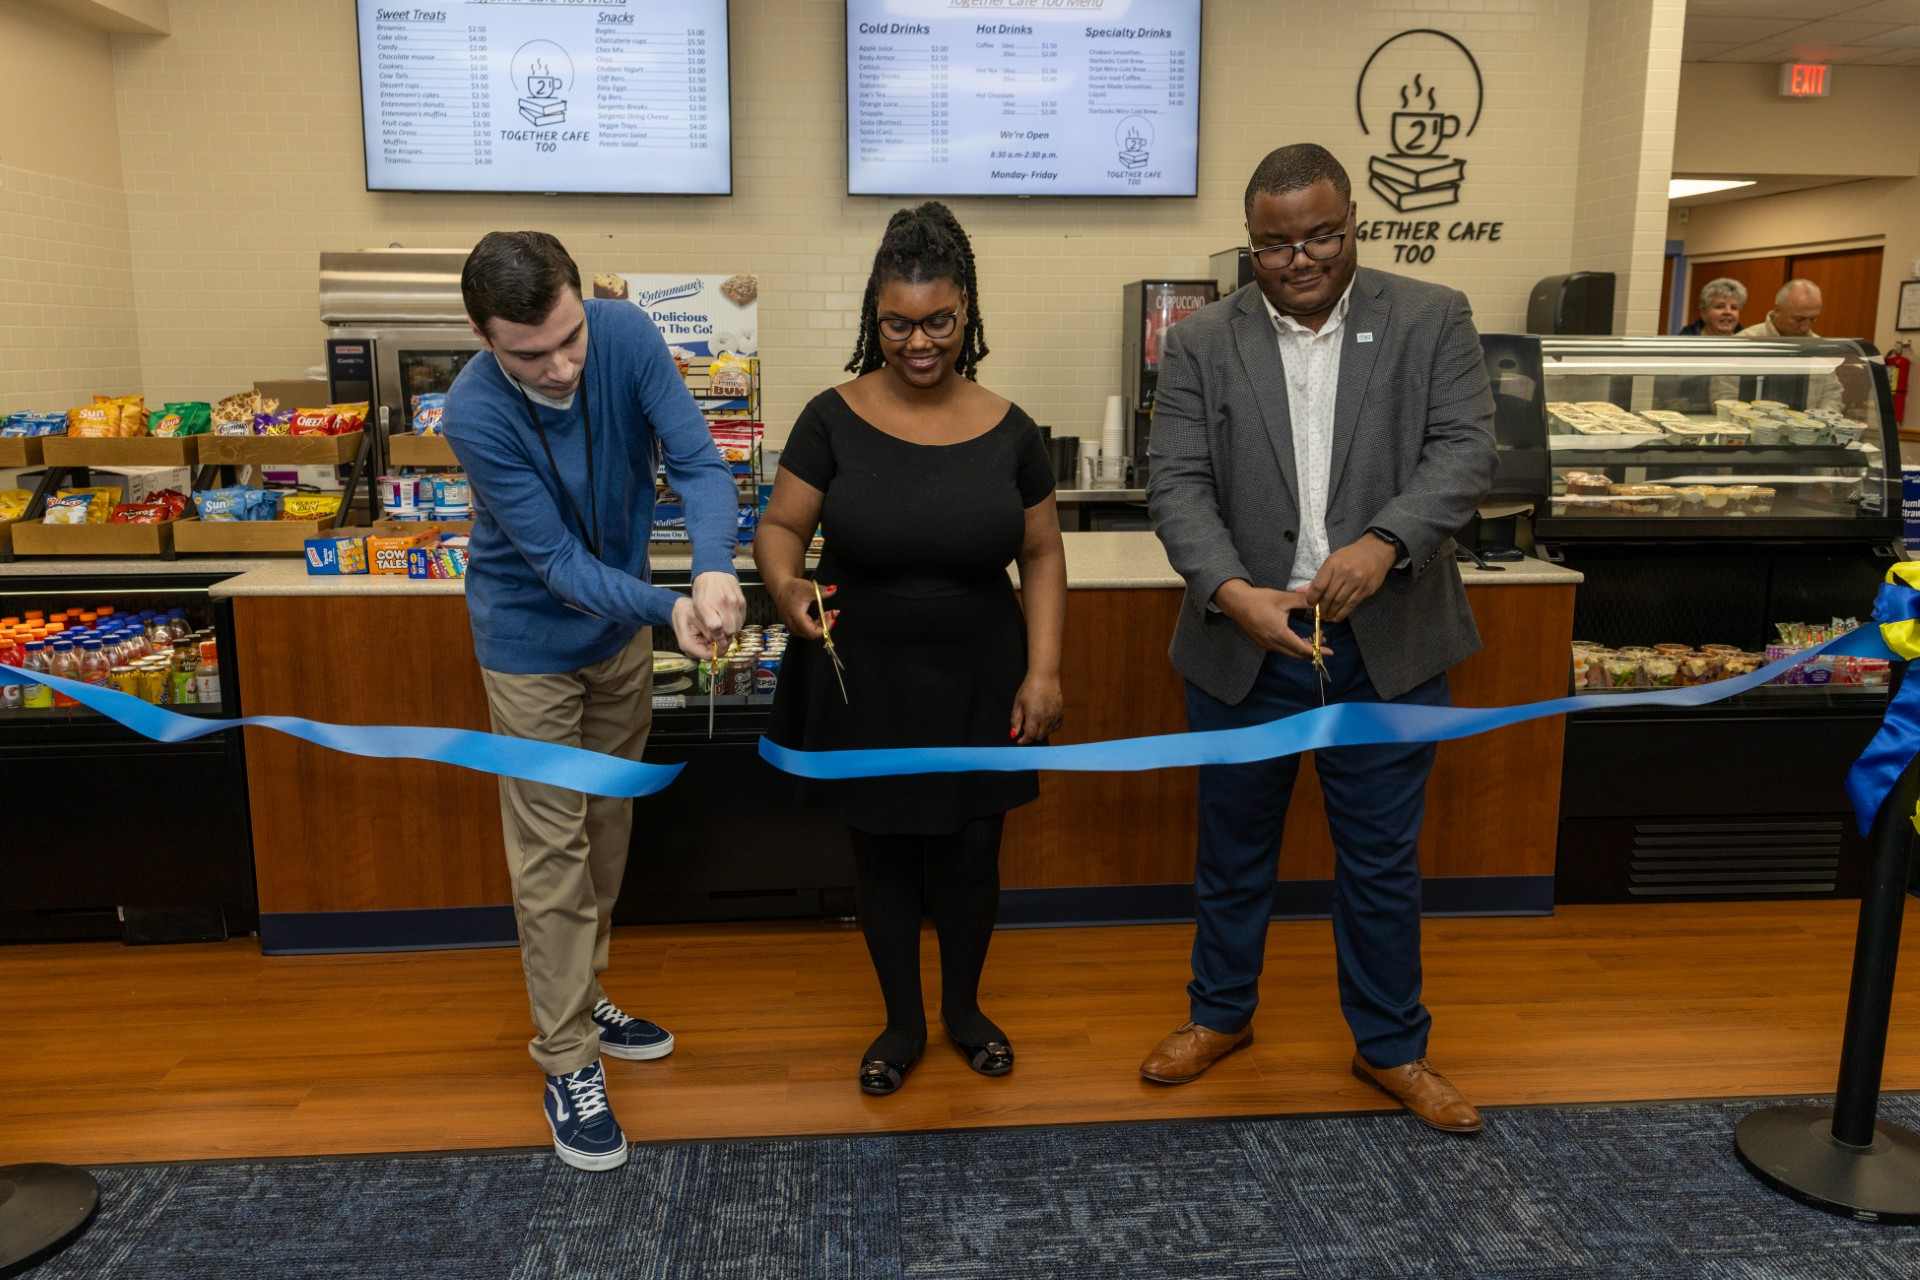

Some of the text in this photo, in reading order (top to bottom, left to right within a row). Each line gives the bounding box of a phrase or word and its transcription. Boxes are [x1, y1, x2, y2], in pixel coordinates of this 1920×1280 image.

[376, 8, 447, 21] Sweet Treats
[597, 12, 635, 23] Snacks
[859, 23, 930, 34] Cold Drinks
[976, 24, 1033, 34] Hot Drinks
[1085, 27, 1172, 39] Specialty Drinks
[1791, 64, 1825, 96] EXIT
[501, 130, 591, 141] TOGETHER CAFE
[1026, 131, 1050, 140] Open
[536, 142, 557, 153] TOO
[1031, 170, 1058, 180] Friday
[1128, 178, 1141, 186] TOO
[1356, 221, 1504, 242] GETHER CAFE
[1393, 244, 1436, 264] TOO
[638, 277, 704, 308] Entenmann's
[1156, 295, 1206, 310] CAPPUCCINO
[652, 311, 709, 322] Delicious
[669, 324, 690, 334] The
[692, 324, 713, 335] Go!
[79, 408, 105, 418] Sun
[205, 500, 226, 512] Sun
[376, 550, 405, 560] COW
[376, 560, 408, 569] TALES
